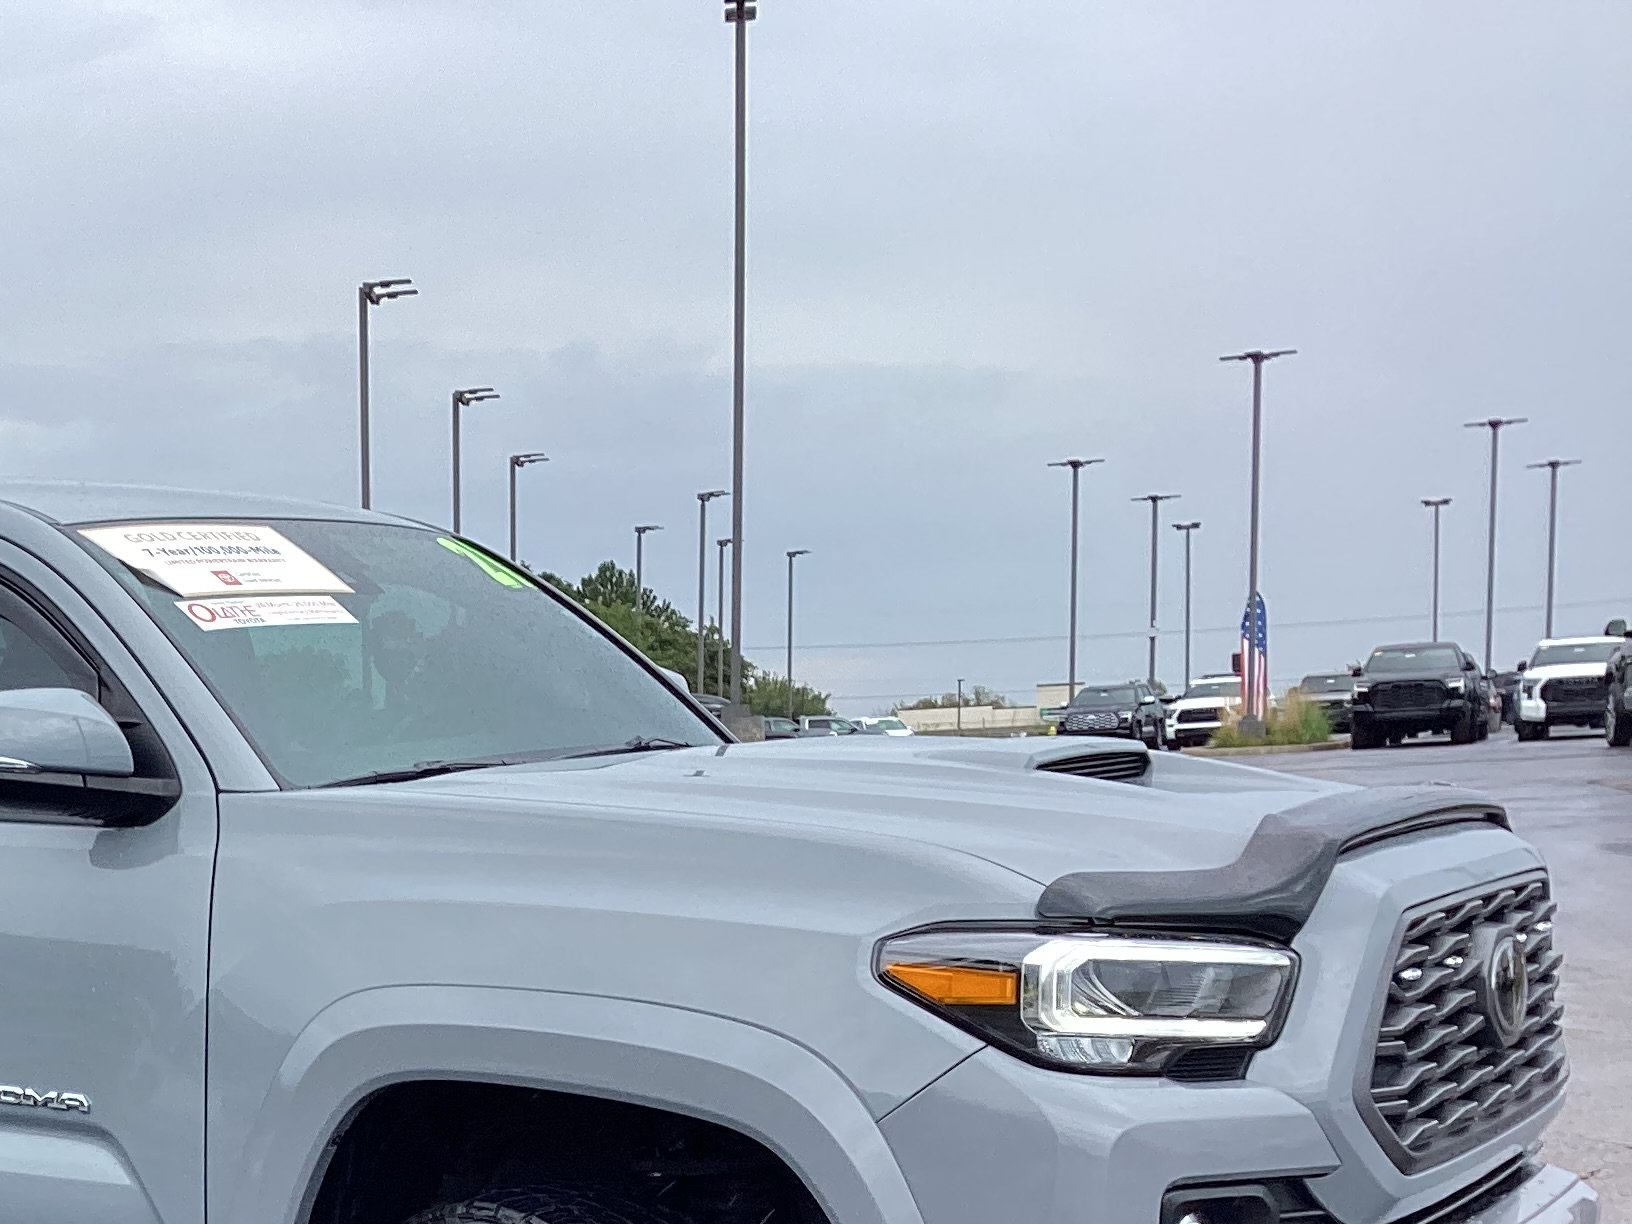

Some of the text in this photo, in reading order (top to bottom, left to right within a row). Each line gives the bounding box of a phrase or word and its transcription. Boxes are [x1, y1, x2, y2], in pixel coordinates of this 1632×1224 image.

[124, 531, 261, 542] GOLD CERTIFIED
[187, 603, 261, 622] OLATHE
